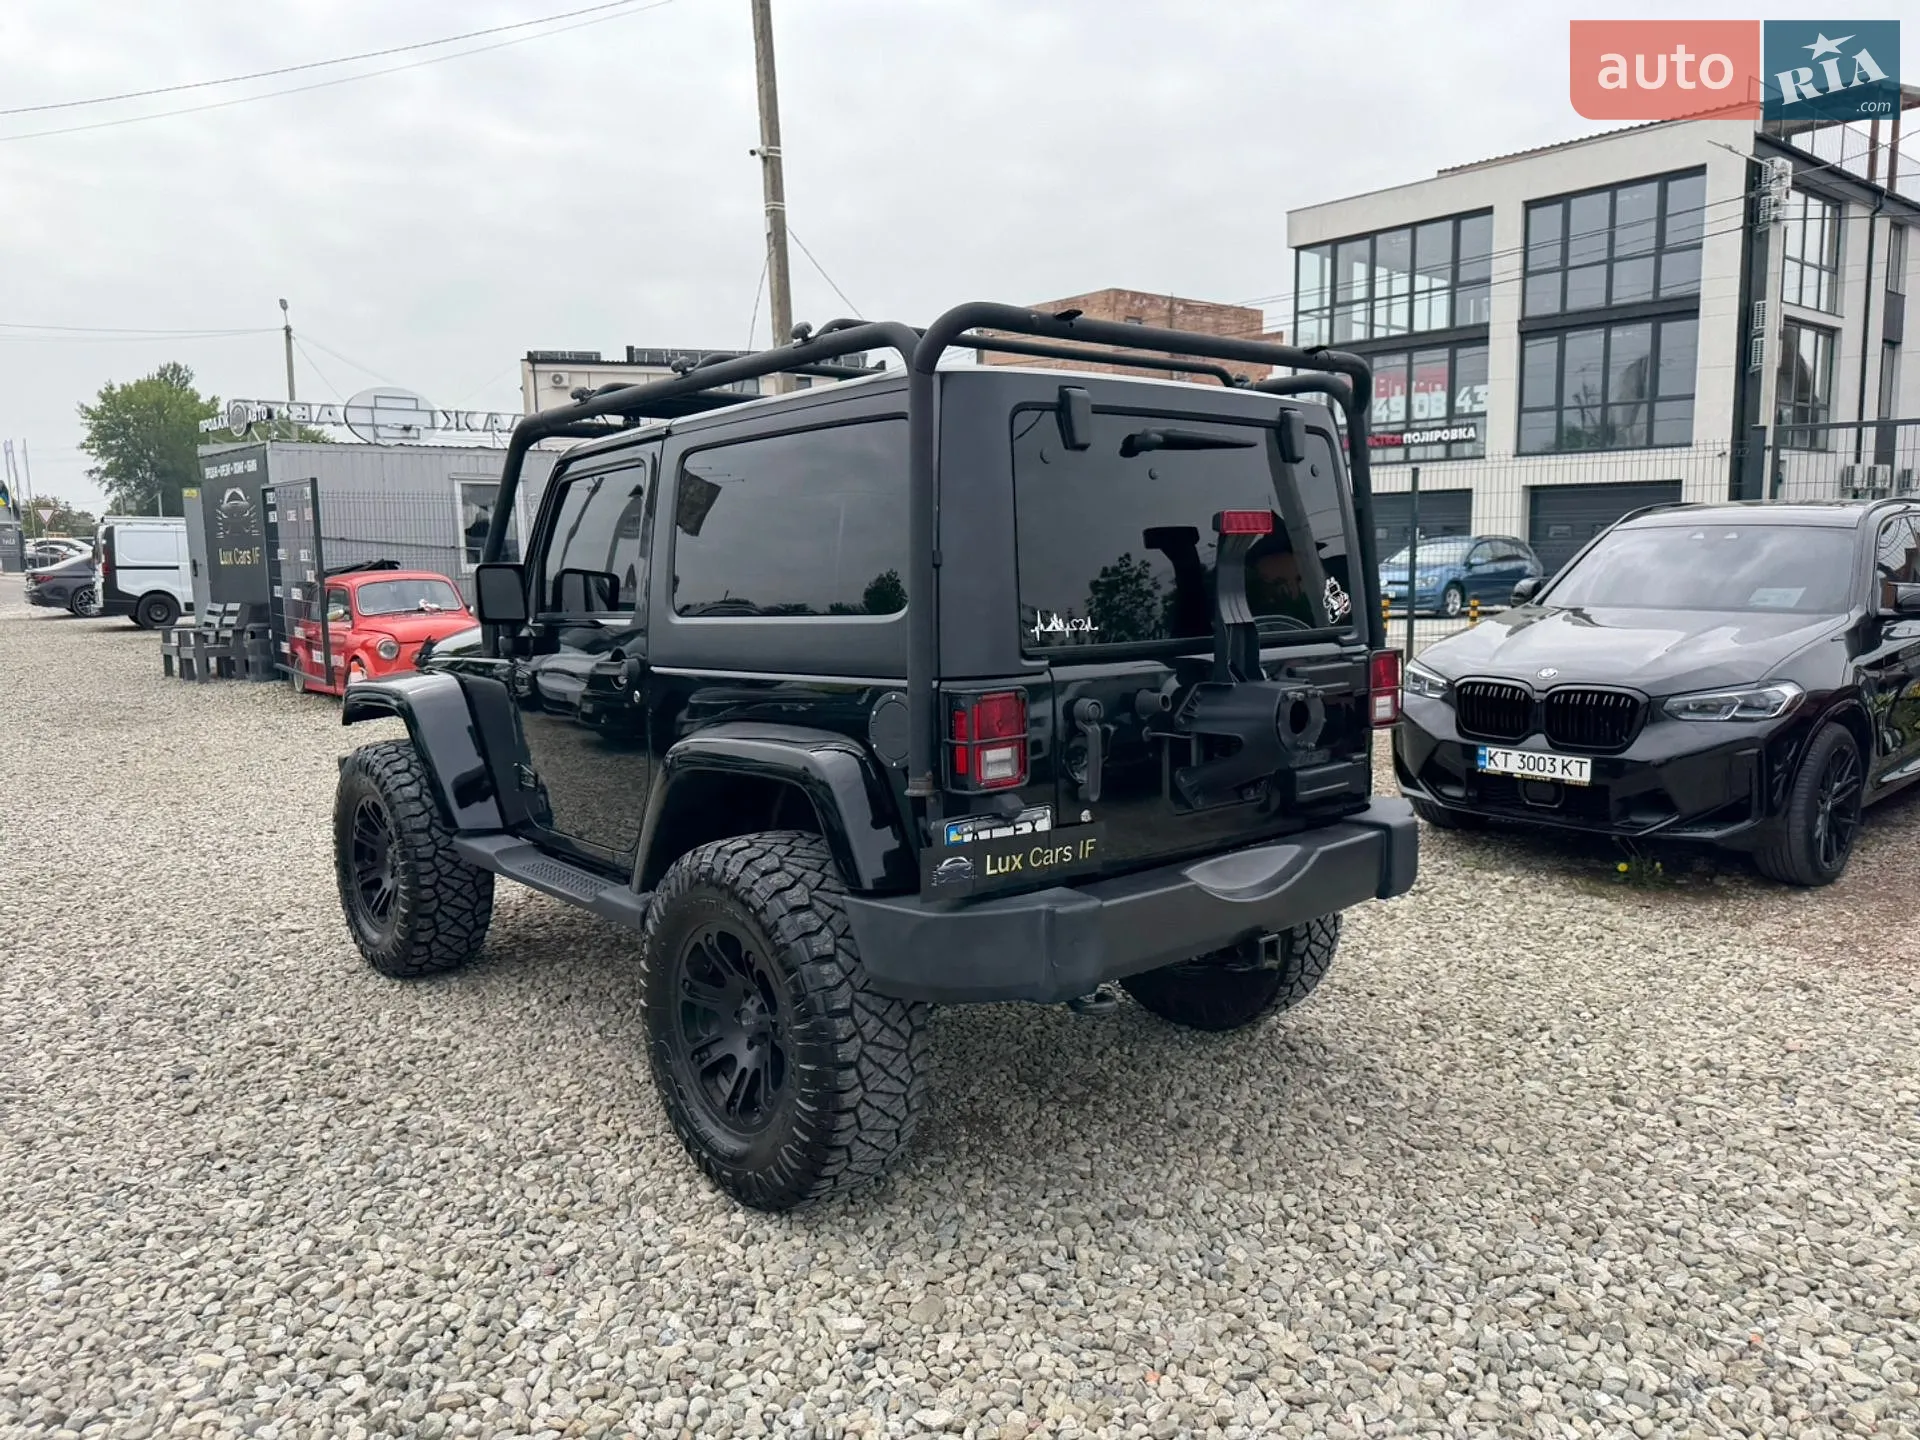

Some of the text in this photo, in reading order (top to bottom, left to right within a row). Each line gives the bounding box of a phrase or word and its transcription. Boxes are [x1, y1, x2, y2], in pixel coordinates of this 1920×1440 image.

[1403, 427, 1476, 444] ПОЛІРОВКА
[219, 547, 232, 565] Lux
[233, 547, 252, 565] Cars
[253, 546, 261, 564] IF
[1488, 749, 1588, 777] KT 3003 KT
[986, 838, 1097, 875] Lux Cars IF
